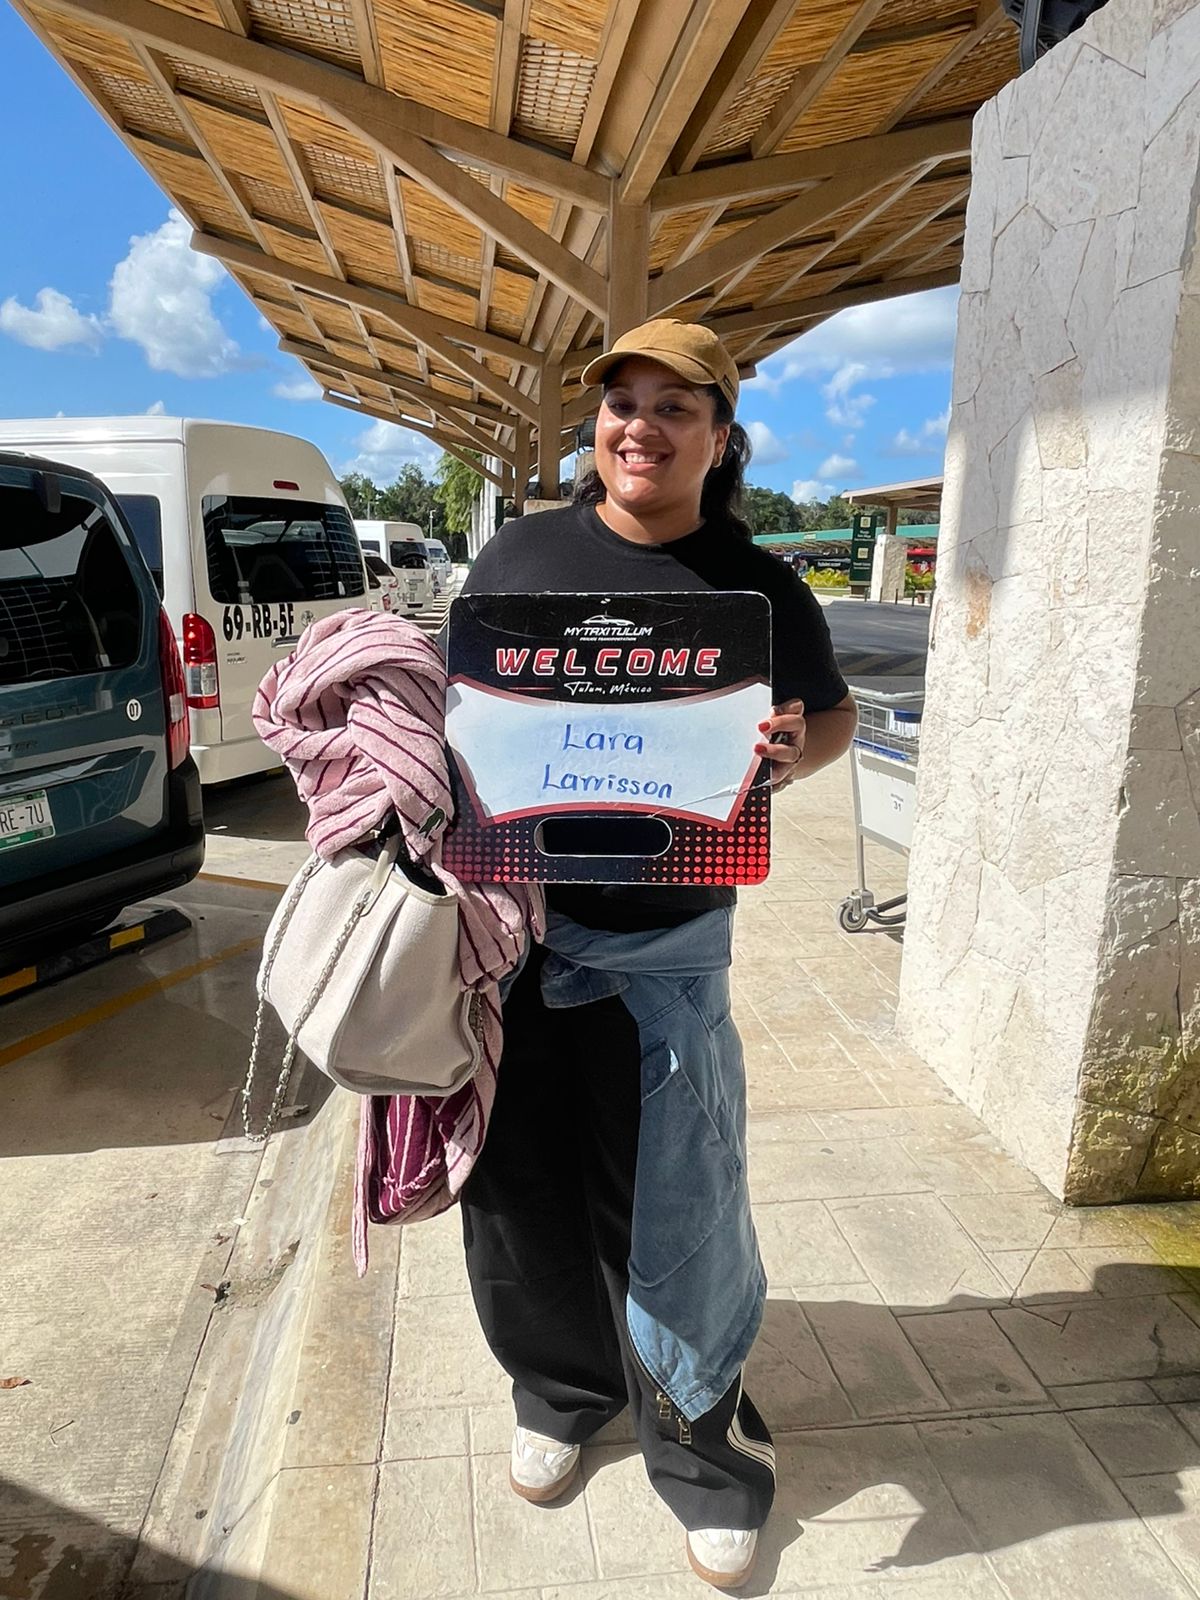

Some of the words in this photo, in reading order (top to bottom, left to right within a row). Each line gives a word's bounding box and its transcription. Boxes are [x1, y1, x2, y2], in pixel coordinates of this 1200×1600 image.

[223, 603, 294, 641] 69-RB-5F
[496, 648, 721, 676] WELCOME
[562, 723, 643, 754] Lara
[542, 764, 672, 798] Larrisson
